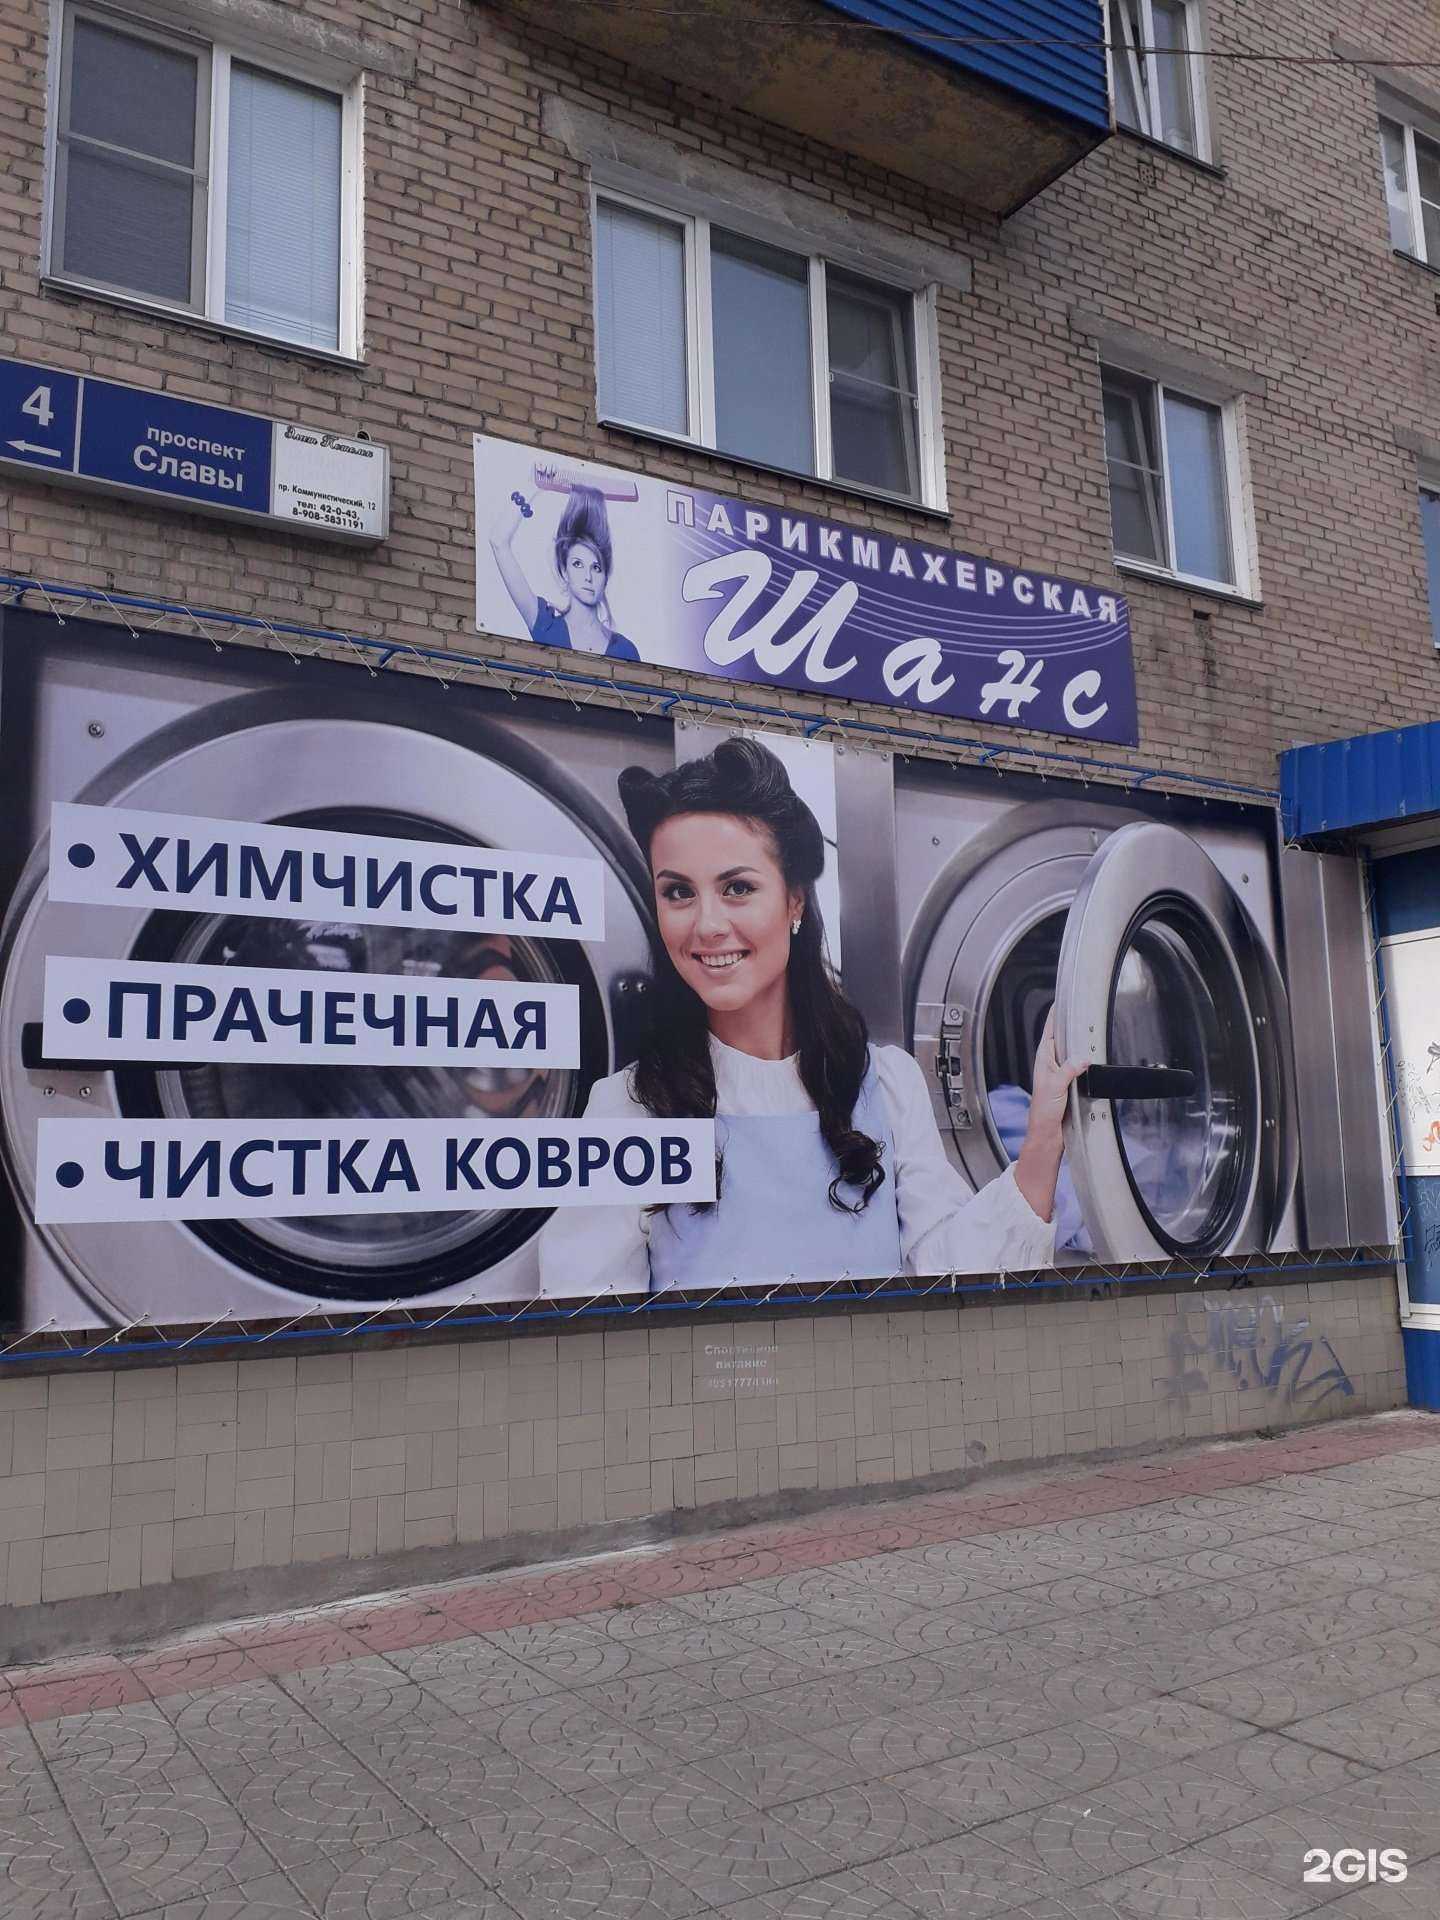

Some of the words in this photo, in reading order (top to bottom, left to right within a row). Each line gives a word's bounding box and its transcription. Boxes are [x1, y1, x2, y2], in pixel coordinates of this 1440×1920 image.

[22, 386, 54, 427] 4
[133, 445, 243, 492] Славы
[147, 427, 246, 461] проспект
[320, 504, 360, 521] 42-0-43,
[666, 490, 1119, 624] ПАРИКМАХЕРСКАЯ
[681, 549, 1110, 729] Шанс
[115, 833, 582, 925] ХИМЧИСТКА
[107, 981, 547, 1050] ПРАЧЕЧНАЯ
[103, 1139, 420, 1199] ЧИСТКА
[445, 1135, 693, 1191] КОВРОВ
